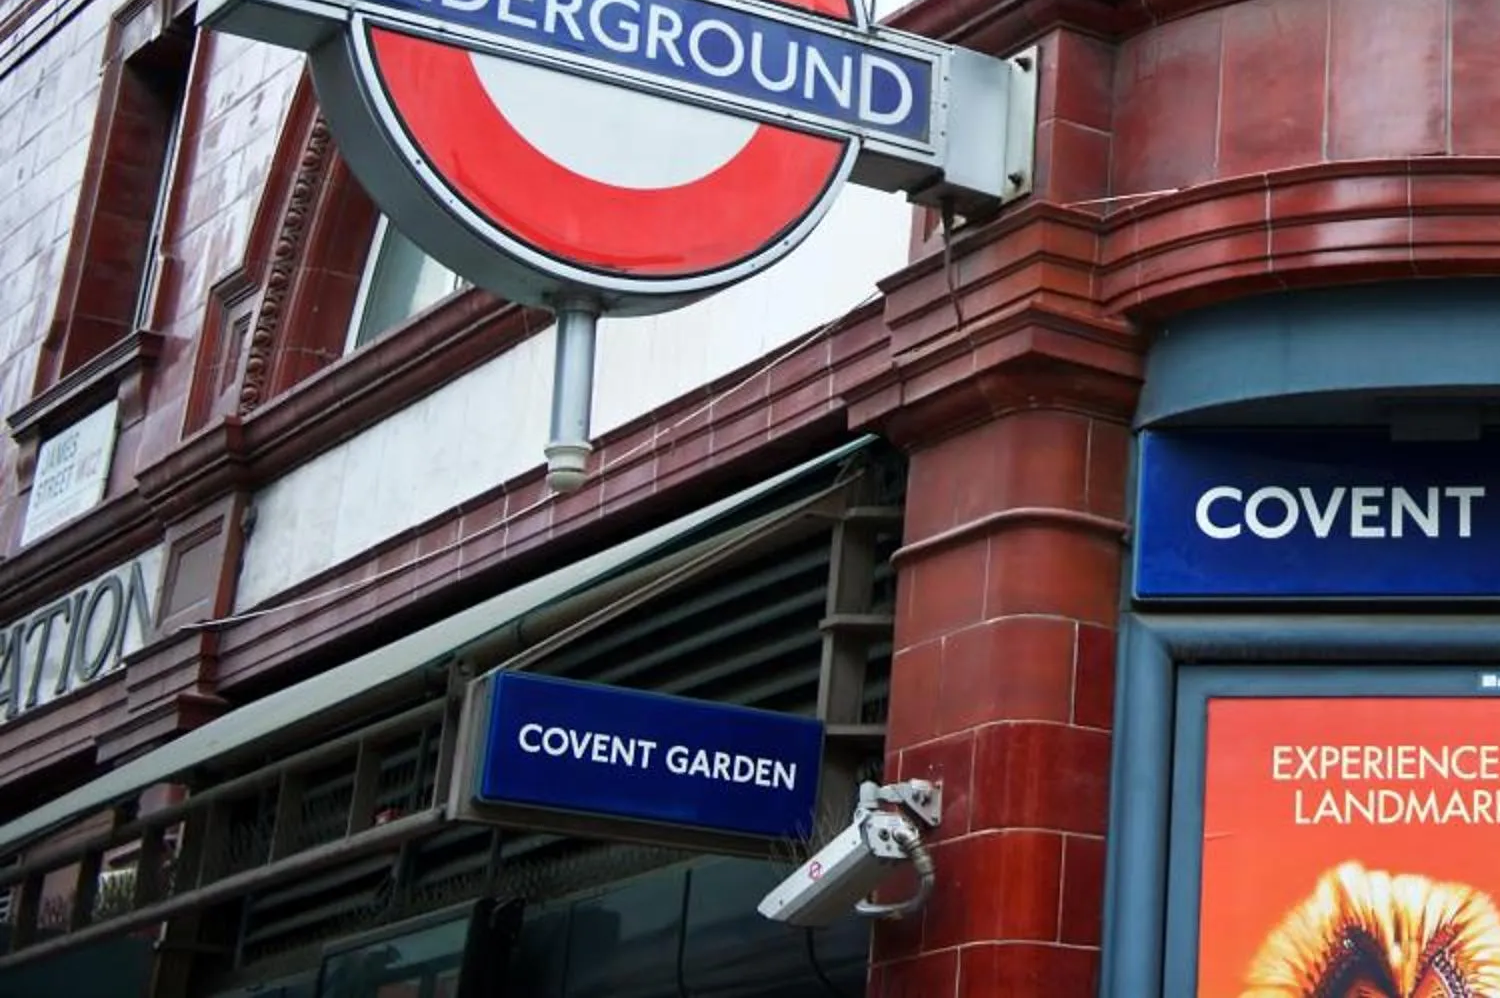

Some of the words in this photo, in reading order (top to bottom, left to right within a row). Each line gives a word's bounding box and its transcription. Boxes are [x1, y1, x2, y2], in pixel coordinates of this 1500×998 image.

[1196, 486, 1485, 539] COVENT
[518, 723, 657, 769] COVENT
[665, 745, 797, 790] GARDEN
[1273, 745, 1499, 780] EXPERIENCE
